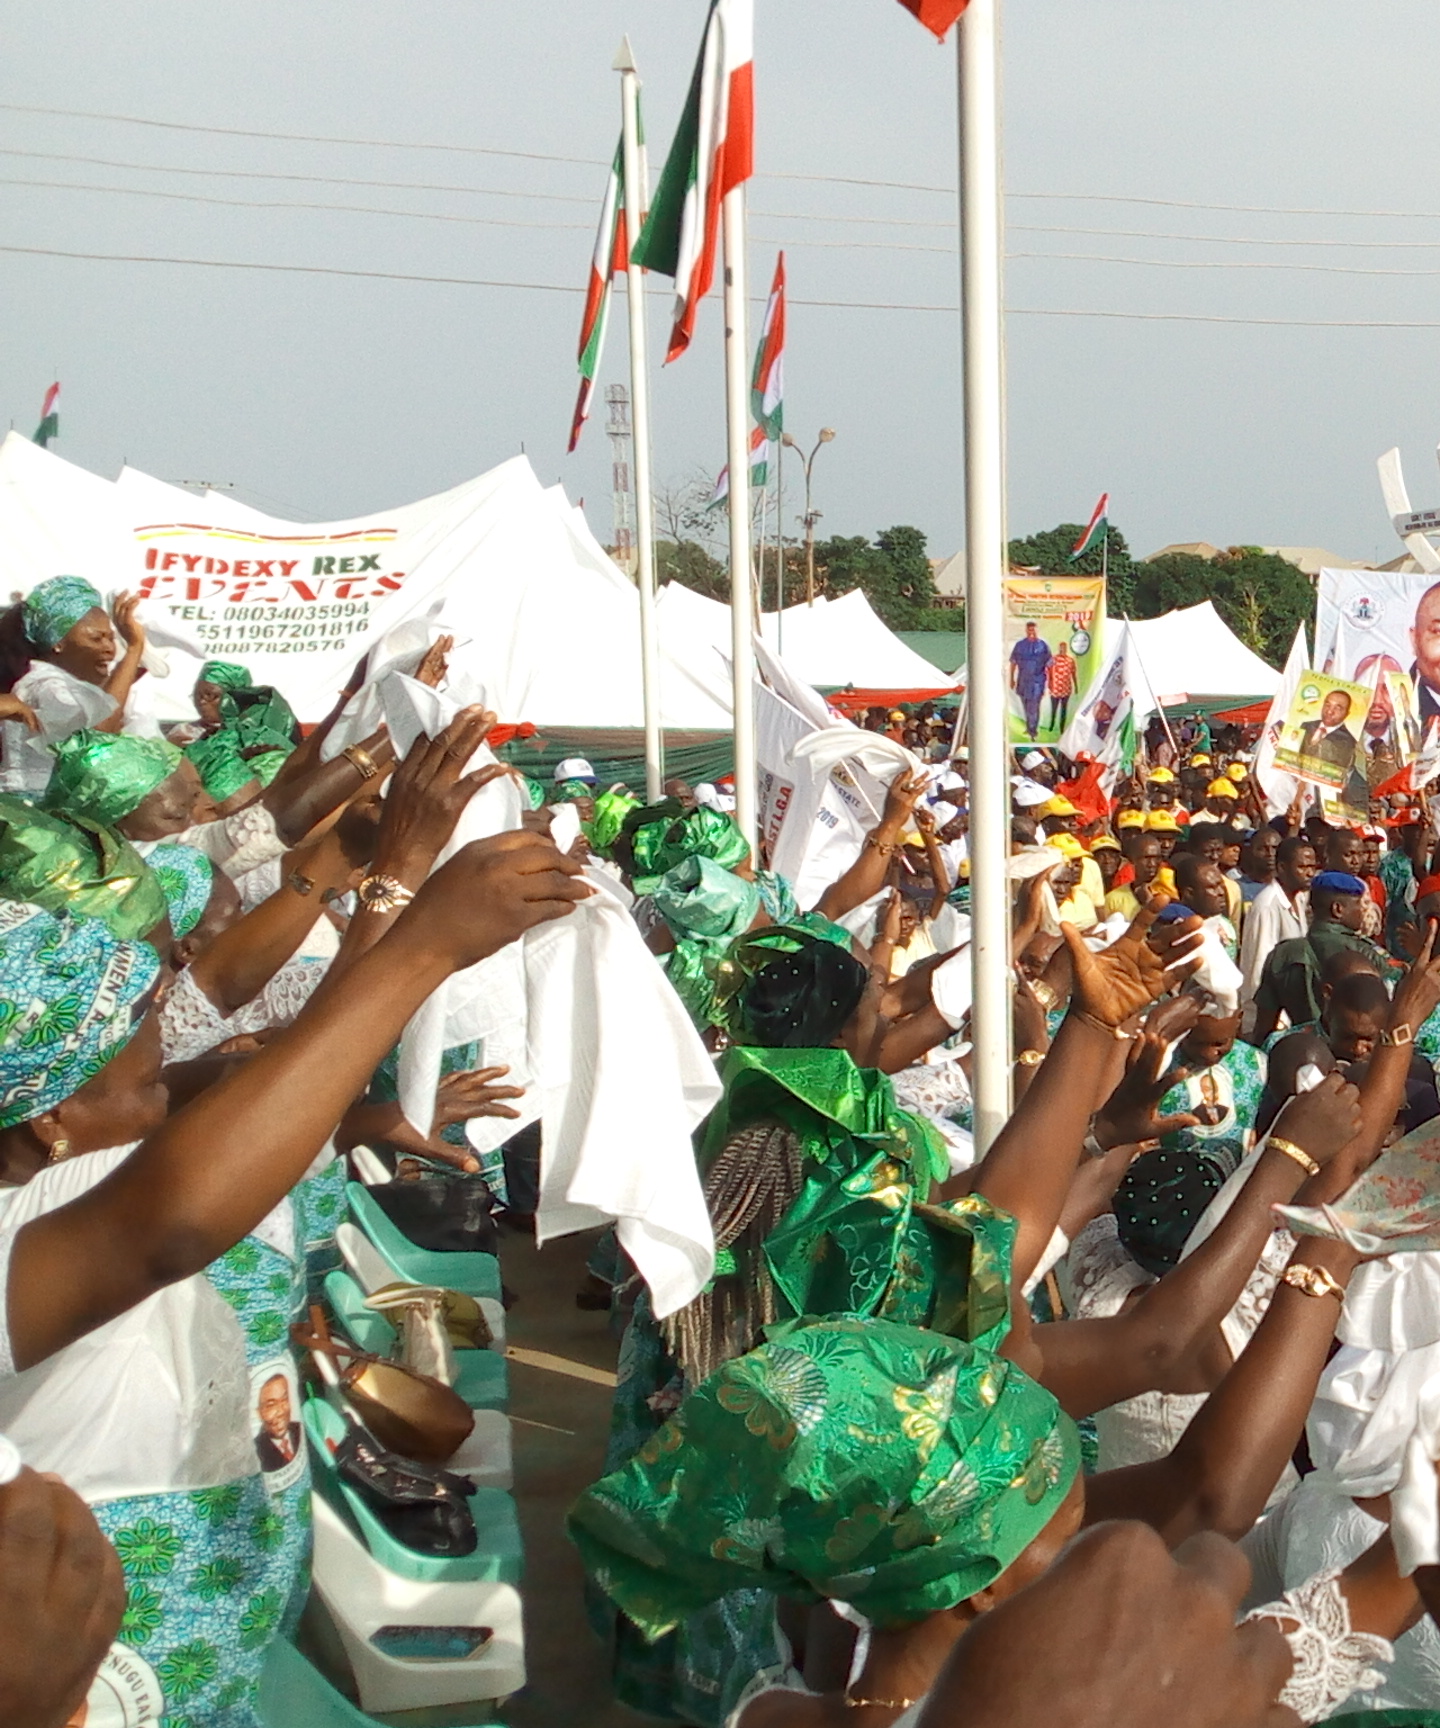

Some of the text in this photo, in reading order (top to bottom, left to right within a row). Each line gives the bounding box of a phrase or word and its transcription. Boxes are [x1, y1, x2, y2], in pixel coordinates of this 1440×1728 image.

[145, 547, 382, 577] IFYDEXY REX
[138, 571, 406, 602] EVENTS
[168, 601, 370, 621] TEL: 08034035994
[837, 787, 861, 808] STATE
[816, 806, 839, 829] 2019
